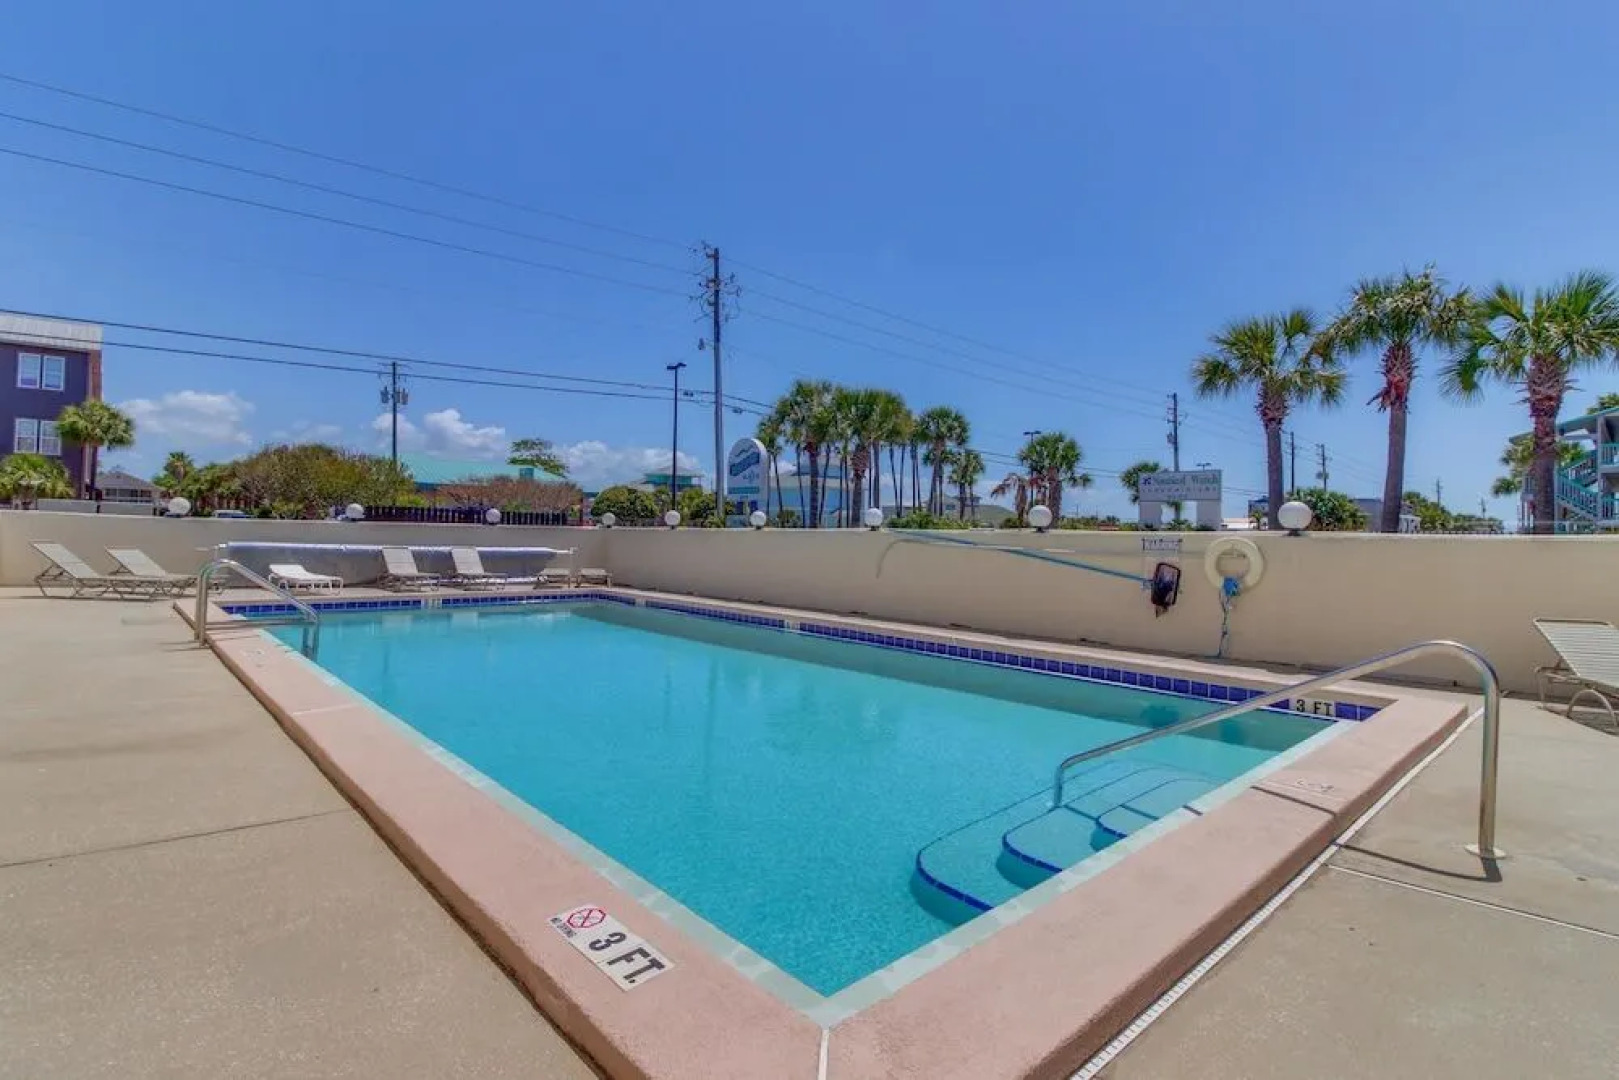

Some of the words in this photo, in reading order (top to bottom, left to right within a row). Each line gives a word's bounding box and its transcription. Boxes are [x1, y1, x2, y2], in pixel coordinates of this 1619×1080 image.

[1296, 699, 1305, 712] 3
[1313, 701, 1333, 716] FT
[588, 932, 627, 951] 3
[607, 946, 666, 984] FT.
